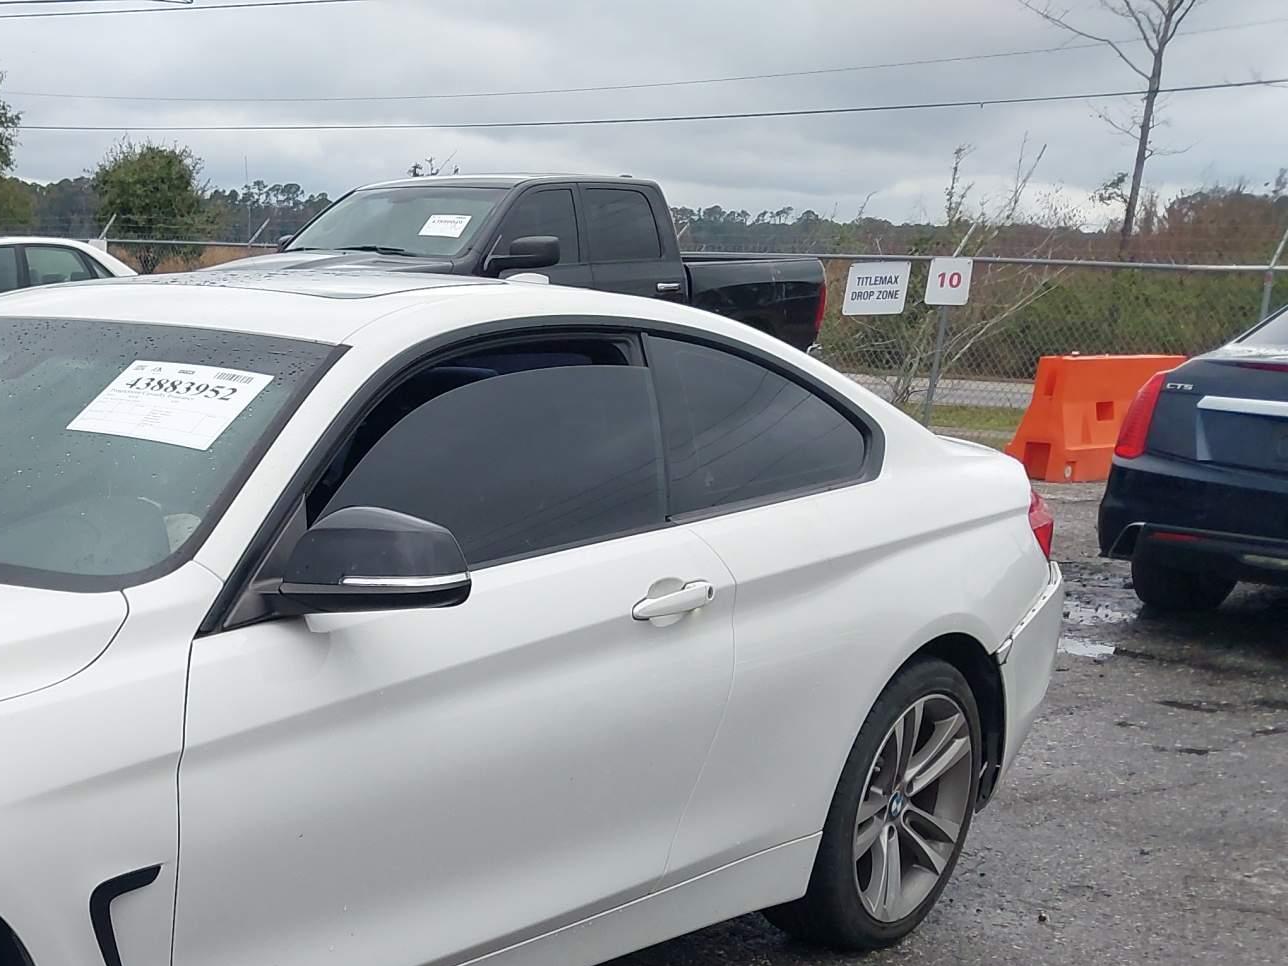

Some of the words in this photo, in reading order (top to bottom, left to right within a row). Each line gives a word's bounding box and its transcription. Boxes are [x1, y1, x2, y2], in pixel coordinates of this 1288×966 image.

[856, 275, 900, 287] TITLEMAX
[938, 272, 962, 288] 10
[850, 290, 875, 301] DROP
[876, 289, 900, 300] ZONE
[125, 376, 238, 401] 43883952
[1166, 382, 1194, 391] CTS
